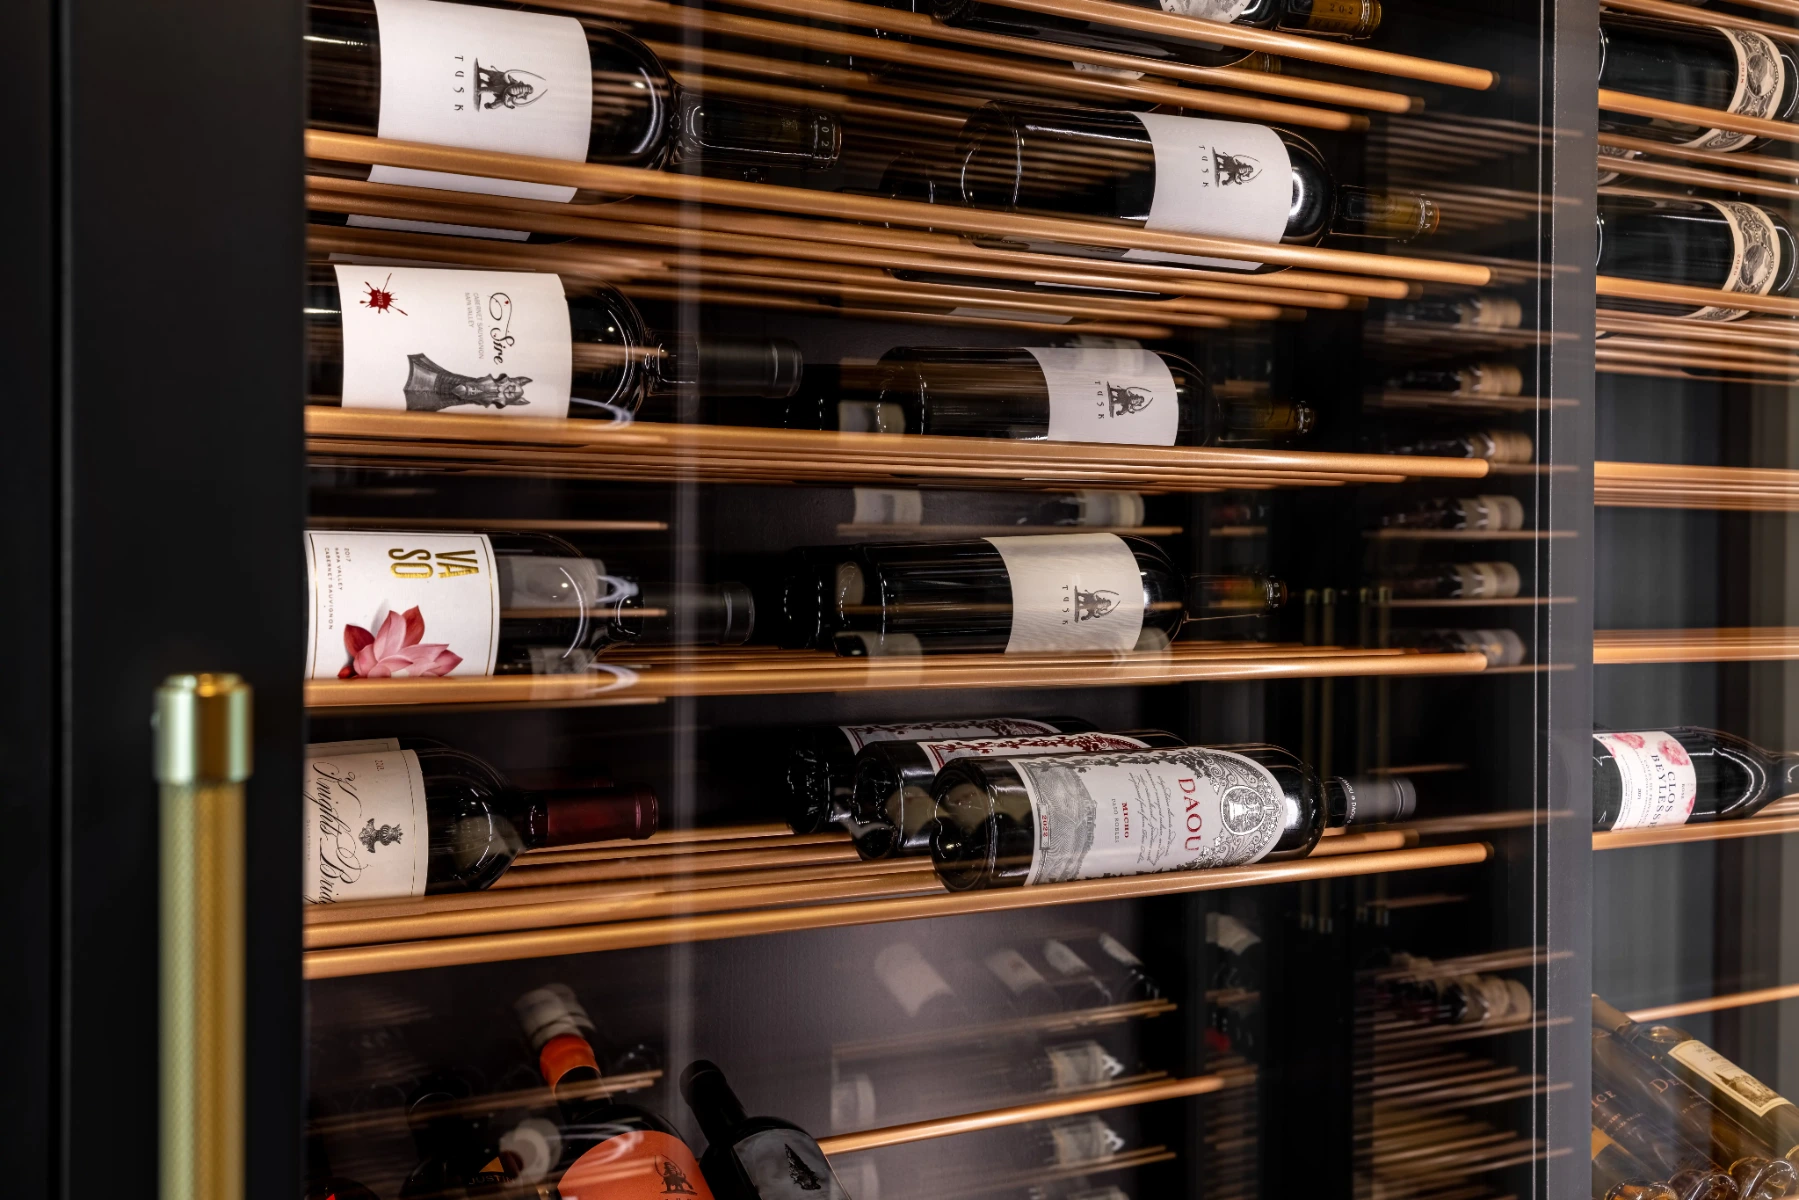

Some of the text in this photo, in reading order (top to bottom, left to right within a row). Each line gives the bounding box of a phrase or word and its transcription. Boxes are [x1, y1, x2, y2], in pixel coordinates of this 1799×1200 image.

[452, 55, 465, 111] TUSK
[1198, 145, 1210, 188] TUSK
[467, 306, 475, 328] VALLEY
[473, 292, 485, 360] CABERNET SAUVIGNON
[1094, 381, 1105, 419] TUSK
[324, 547, 333, 581] CABERNET
[334, 547, 342, 563] NAPA
[344, 547, 352, 562] 2017
[388, 548, 434, 579] SO
[434, 549, 480, 579] VA
[1062, 585, 1070, 625] TUSK
[1665, 771, 1676, 812] CLOS
[1041, 814, 1049, 838] 2022
[1121, 802, 1129, 838] MICHO
[1178, 778, 1203, 851] DAOU
